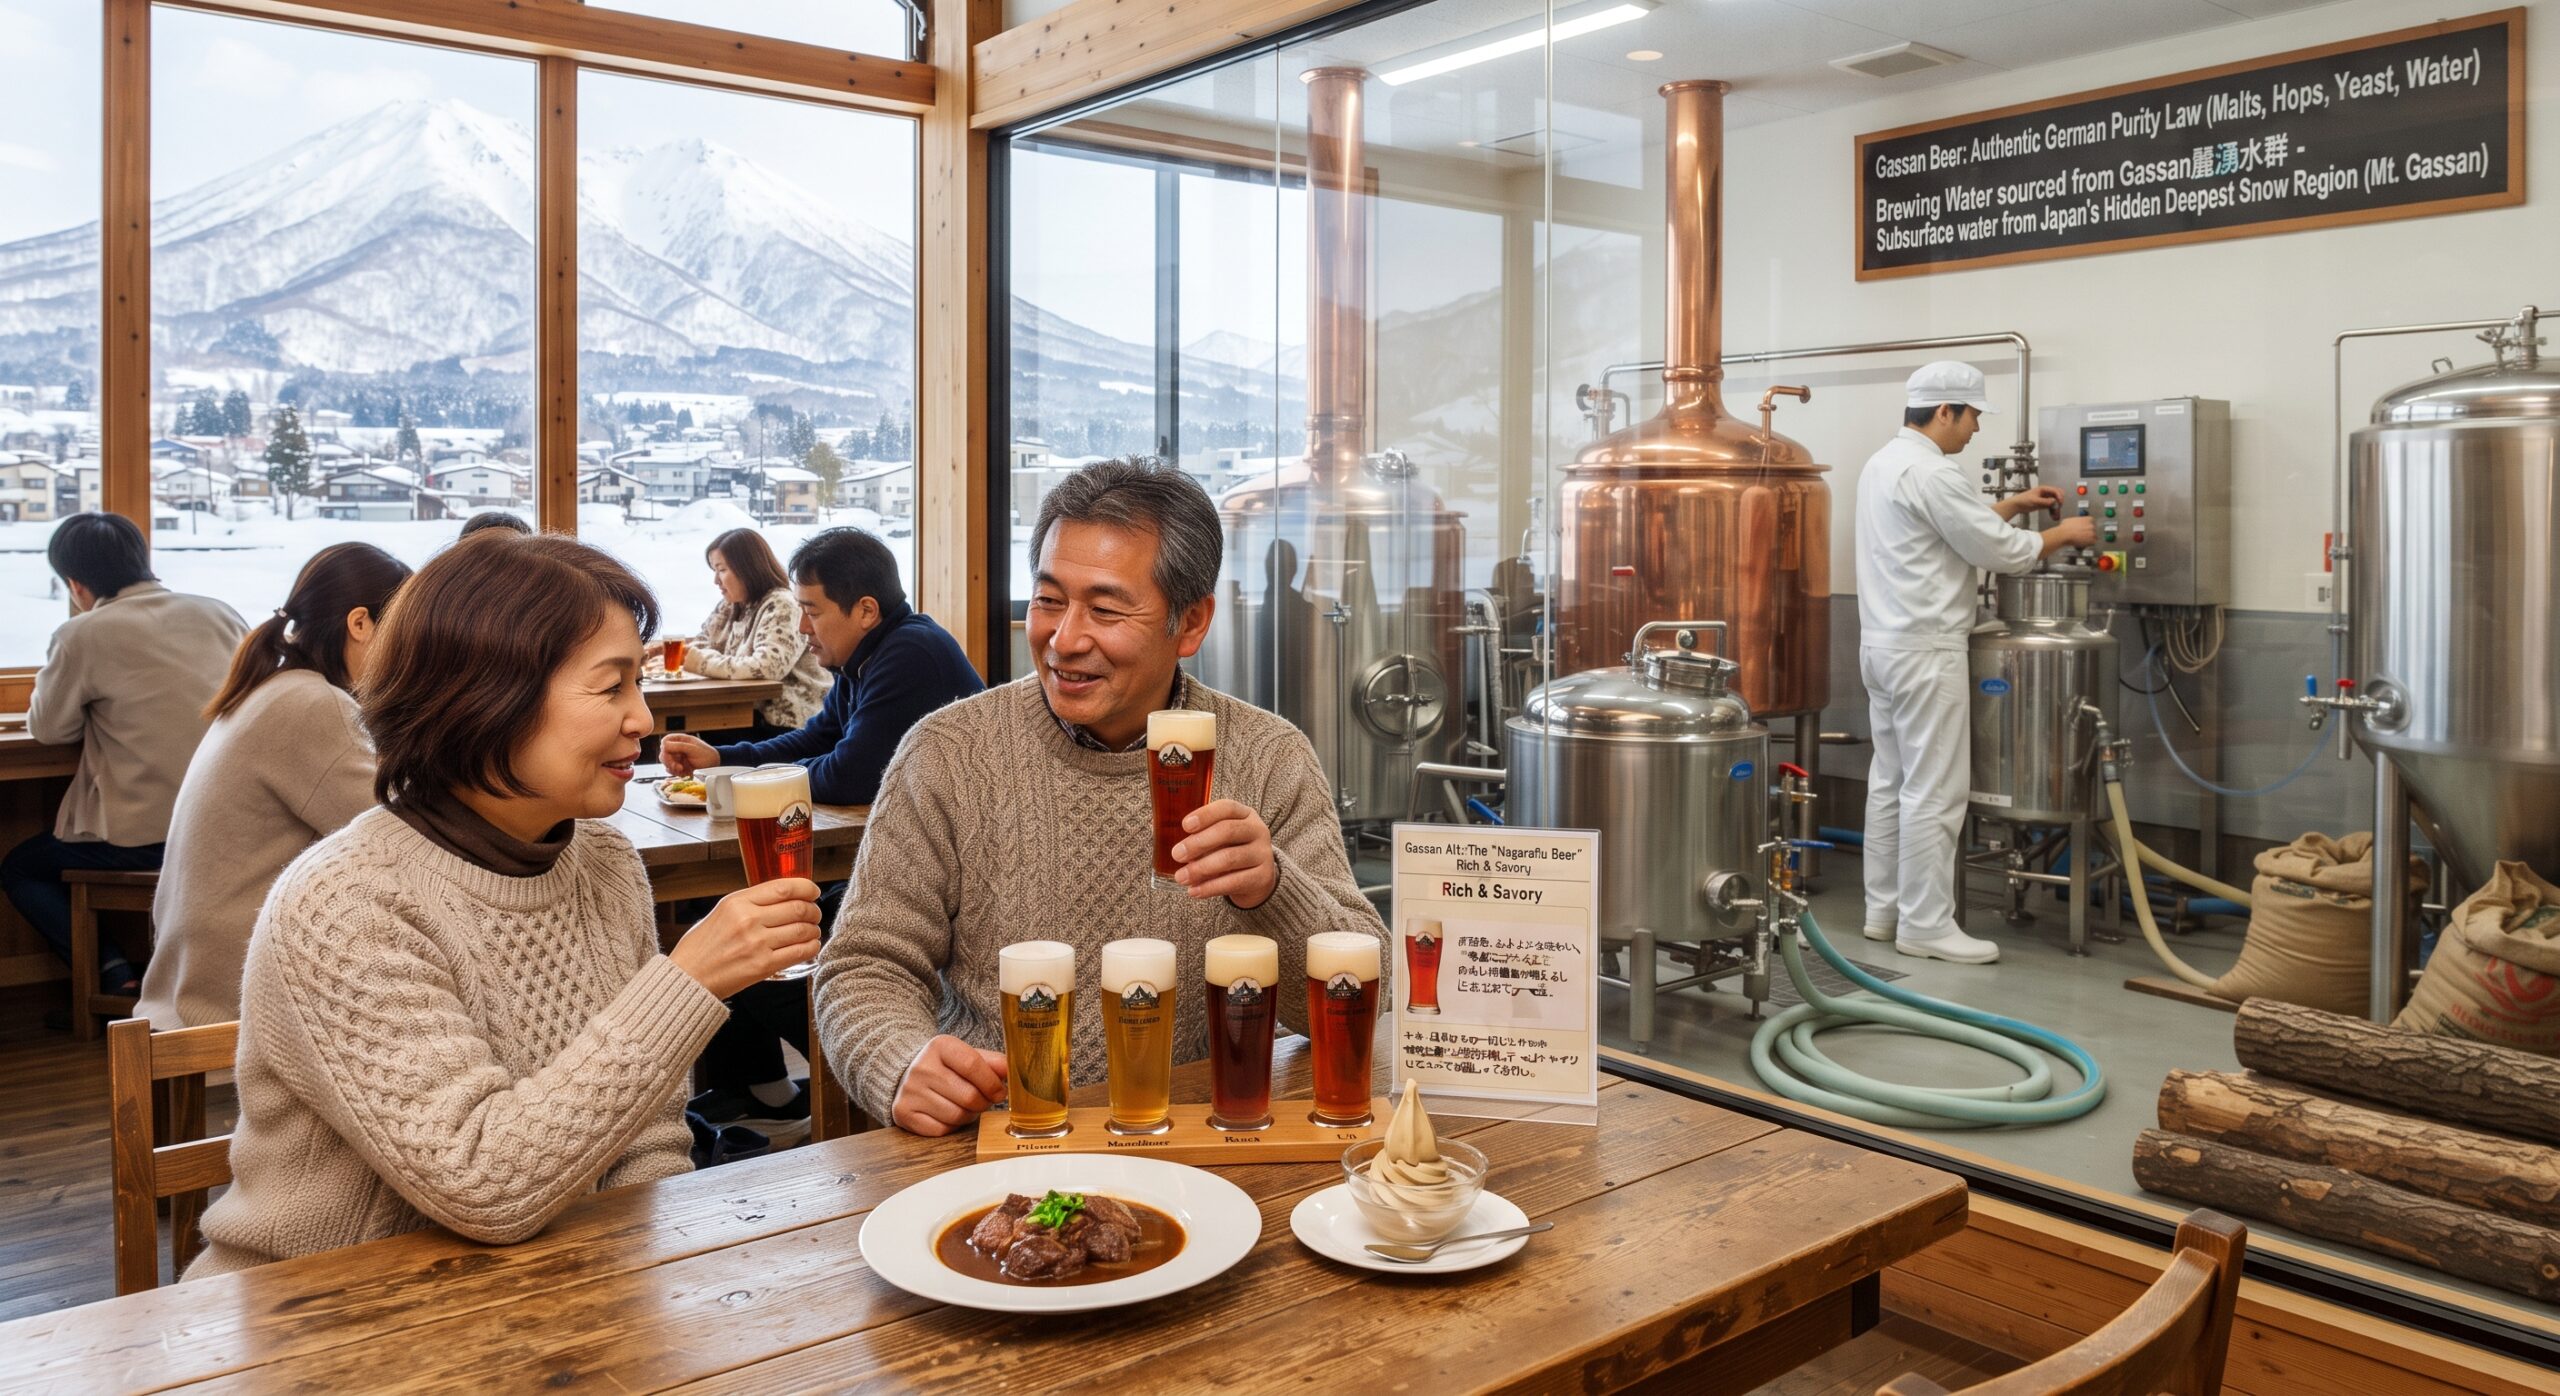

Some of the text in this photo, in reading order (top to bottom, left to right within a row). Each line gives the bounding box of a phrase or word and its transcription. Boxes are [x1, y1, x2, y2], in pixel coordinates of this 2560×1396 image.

[1876, 47, 2481, 179] Gassan Beer: Authentic German Purity Law (Malts, Hops, Yeast, Water)
[1876, 192, 1940, 223] Brewing
[1945, 184, 1993, 212] Water
[1997, 170, 2066, 205] sourced
[2071, 167, 2114, 192] from
[1876, 142, 2489, 252] Subsurface water from Japan's Hidden Deepest Snow Region (Mt. Gassan)
[1405, 842, 1442, 855] Gassan
[1456, 859, 1531, 876] Rich & Savory
[1442, 881, 1543, 904] Rich & Savory
